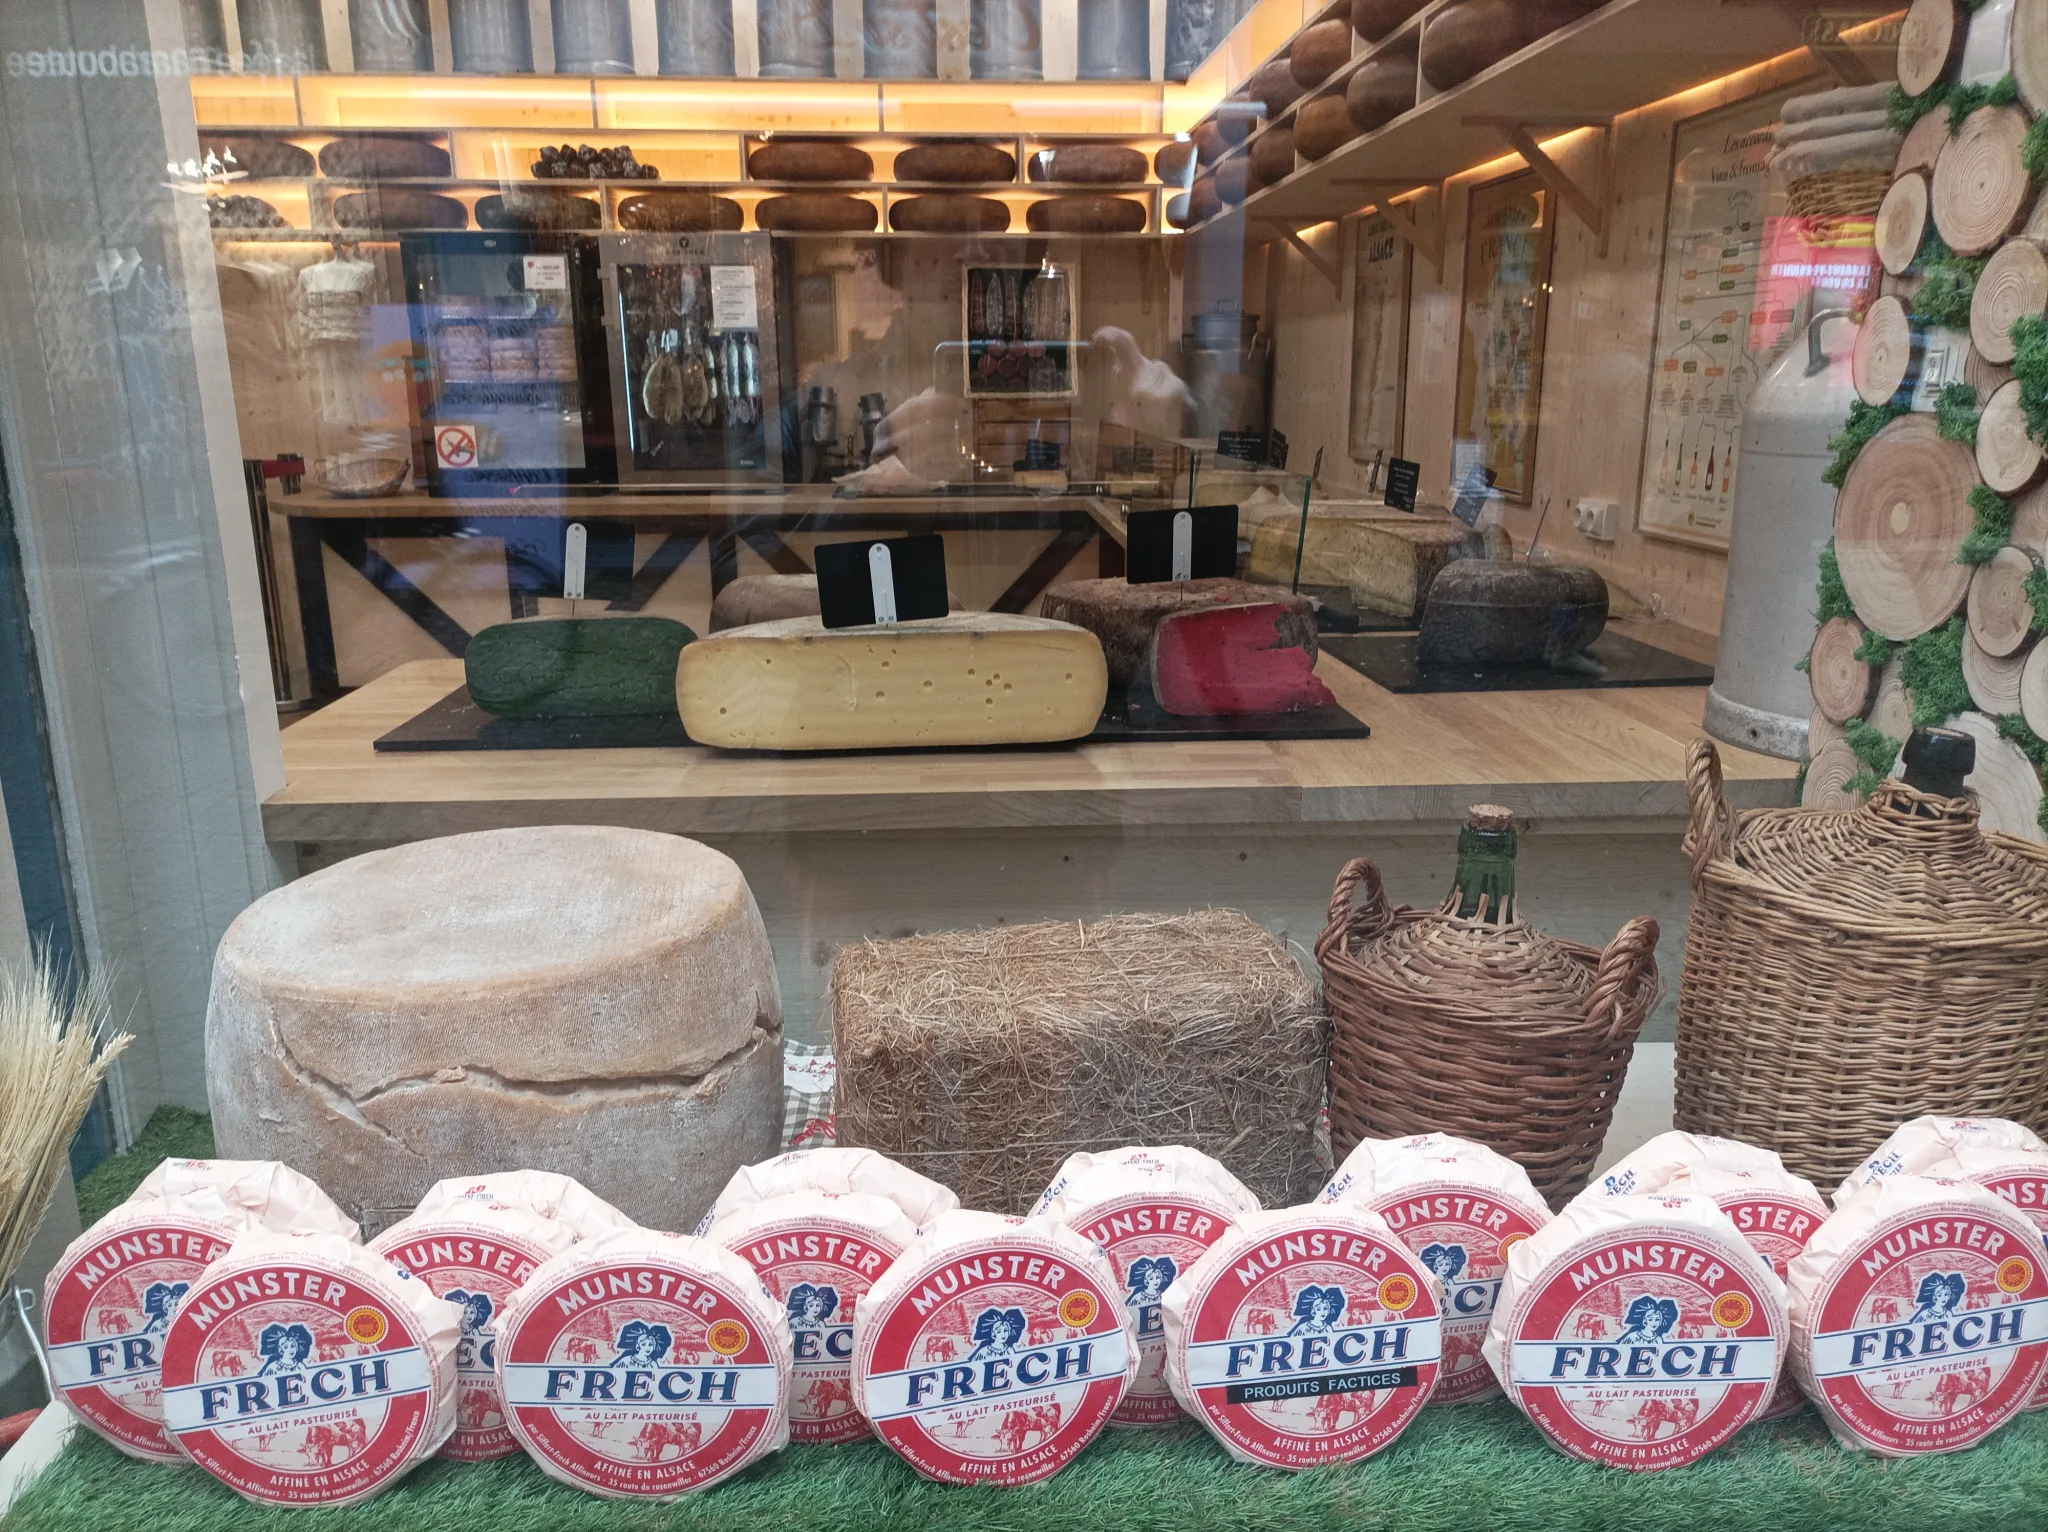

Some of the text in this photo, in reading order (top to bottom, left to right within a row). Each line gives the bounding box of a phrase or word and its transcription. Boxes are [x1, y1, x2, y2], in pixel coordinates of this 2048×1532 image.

[1086, 1209, 1213, 1247] UNSTER
[1385, 1197, 1508, 1233] UNSTER
[1724, 1206, 1810, 1238] STER
[75, 1232, 229, 1291] MUNSTER
[740, 1235, 881, 1275] UNSTER
[1235, 1233, 1387, 1288] MUNSTER
[1861, 1221, 2005, 1278] MUNSTER
[1569, 1245, 1725, 1292] MUNSTER
[188, 1271, 347, 1331] MUNSTER
[555, 1271, 718, 1316] MUNSTER
[911, 1255, 1066, 1317] MUNSTER
[1225, 1326, 1411, 1379] FRECH
[1849, 1308, 2026, 1367] FRECH
[801, 1370, 851, 1379] PASTEURI
[906, 1342, 1093, 1407] FRECH
[1550, 1344, 1743, 1379] FRECH
[1886, 1357, 1988, 1382] AU LAIT PASTEURISÉ
[134, 1381, 148, 1391] AU
[200, 1359, 391, 1421] FRECH
[543, 1369, 741, 1402] FRECH
[1243, 1372, 1401, 1399] PRODUITS FACTICES
[1587, 1387, 1696, 1398] AU LAIT PASTEURISÉ
[584, 1411, 698, 1421] AU LAIT PASTEURISÉ
[947, 1392, 1056, 1421] AU LAIT PASTEURISÉ
[1162, 1398, 1176, 1408] EN
[1831, 1393, 1843, 1404] par
[1905, 1438, 1915, 1447] 35
[1916, 1438, 1934, 1447] route
[1935, 1437, 1944, 1446] de
[248, 1407, 358, 1436] AU LAIT PASTEURISÉ
[461, 1431, 512, 1446] EN ALSAC
[806, 1425, 820, 1434] EN
[1208, 1404, 1220, 1417] par
[1250, 1441, 1280, 1460] Affineurs
[1286, 1454, 1297, 1463] 35
[1298, 1454, 1317, 1464] route
[1371, 1425, 1393, 1445] 67560
[1528, 1403, 1540, 1414] par
[1691, 1441, 1713, 1458] 67560
[1893, 1409, 1985, 1436] AFFINÉ EN ALSACE
[890, 1435, 903, 1447] par
[1060, 1442, 1080, 1462] 67560
[1273, 1426, 1371, 1452] AFFINÉ EN ALSACE
[1590, 1438, 1690, 1458] AFFINÉ EN ALSACE
[193, 1448, 207, 1462] par
[246, 1481, 280, 1498] Affineurs
[288, 1490, 298, 1499] 35
[300, 1490, 320, 1500] route
[321, 1489, 331, 1498] de
[373, 1458, 394, 1477] 67560
[269, 1459, 370, 1488] AFFINÉ EN ALSACE
[526, 1423, 540, 1435] par
[569, 1463, 601, 1482] Affineurs
[607, 1477, 618, 1486] 35
[619, 1480, 639, 1491] route
[641, 1482, 651, 1491] de
[652, 1476, 692, 1491] rosenwiller
[698, 1463, 719, 1479] 67560
[593, 1460, 697, 1480] AFFINÉ EN ALSACE
[959, 1444, 1058, 1475] AFFINÉ EN ALSACE
